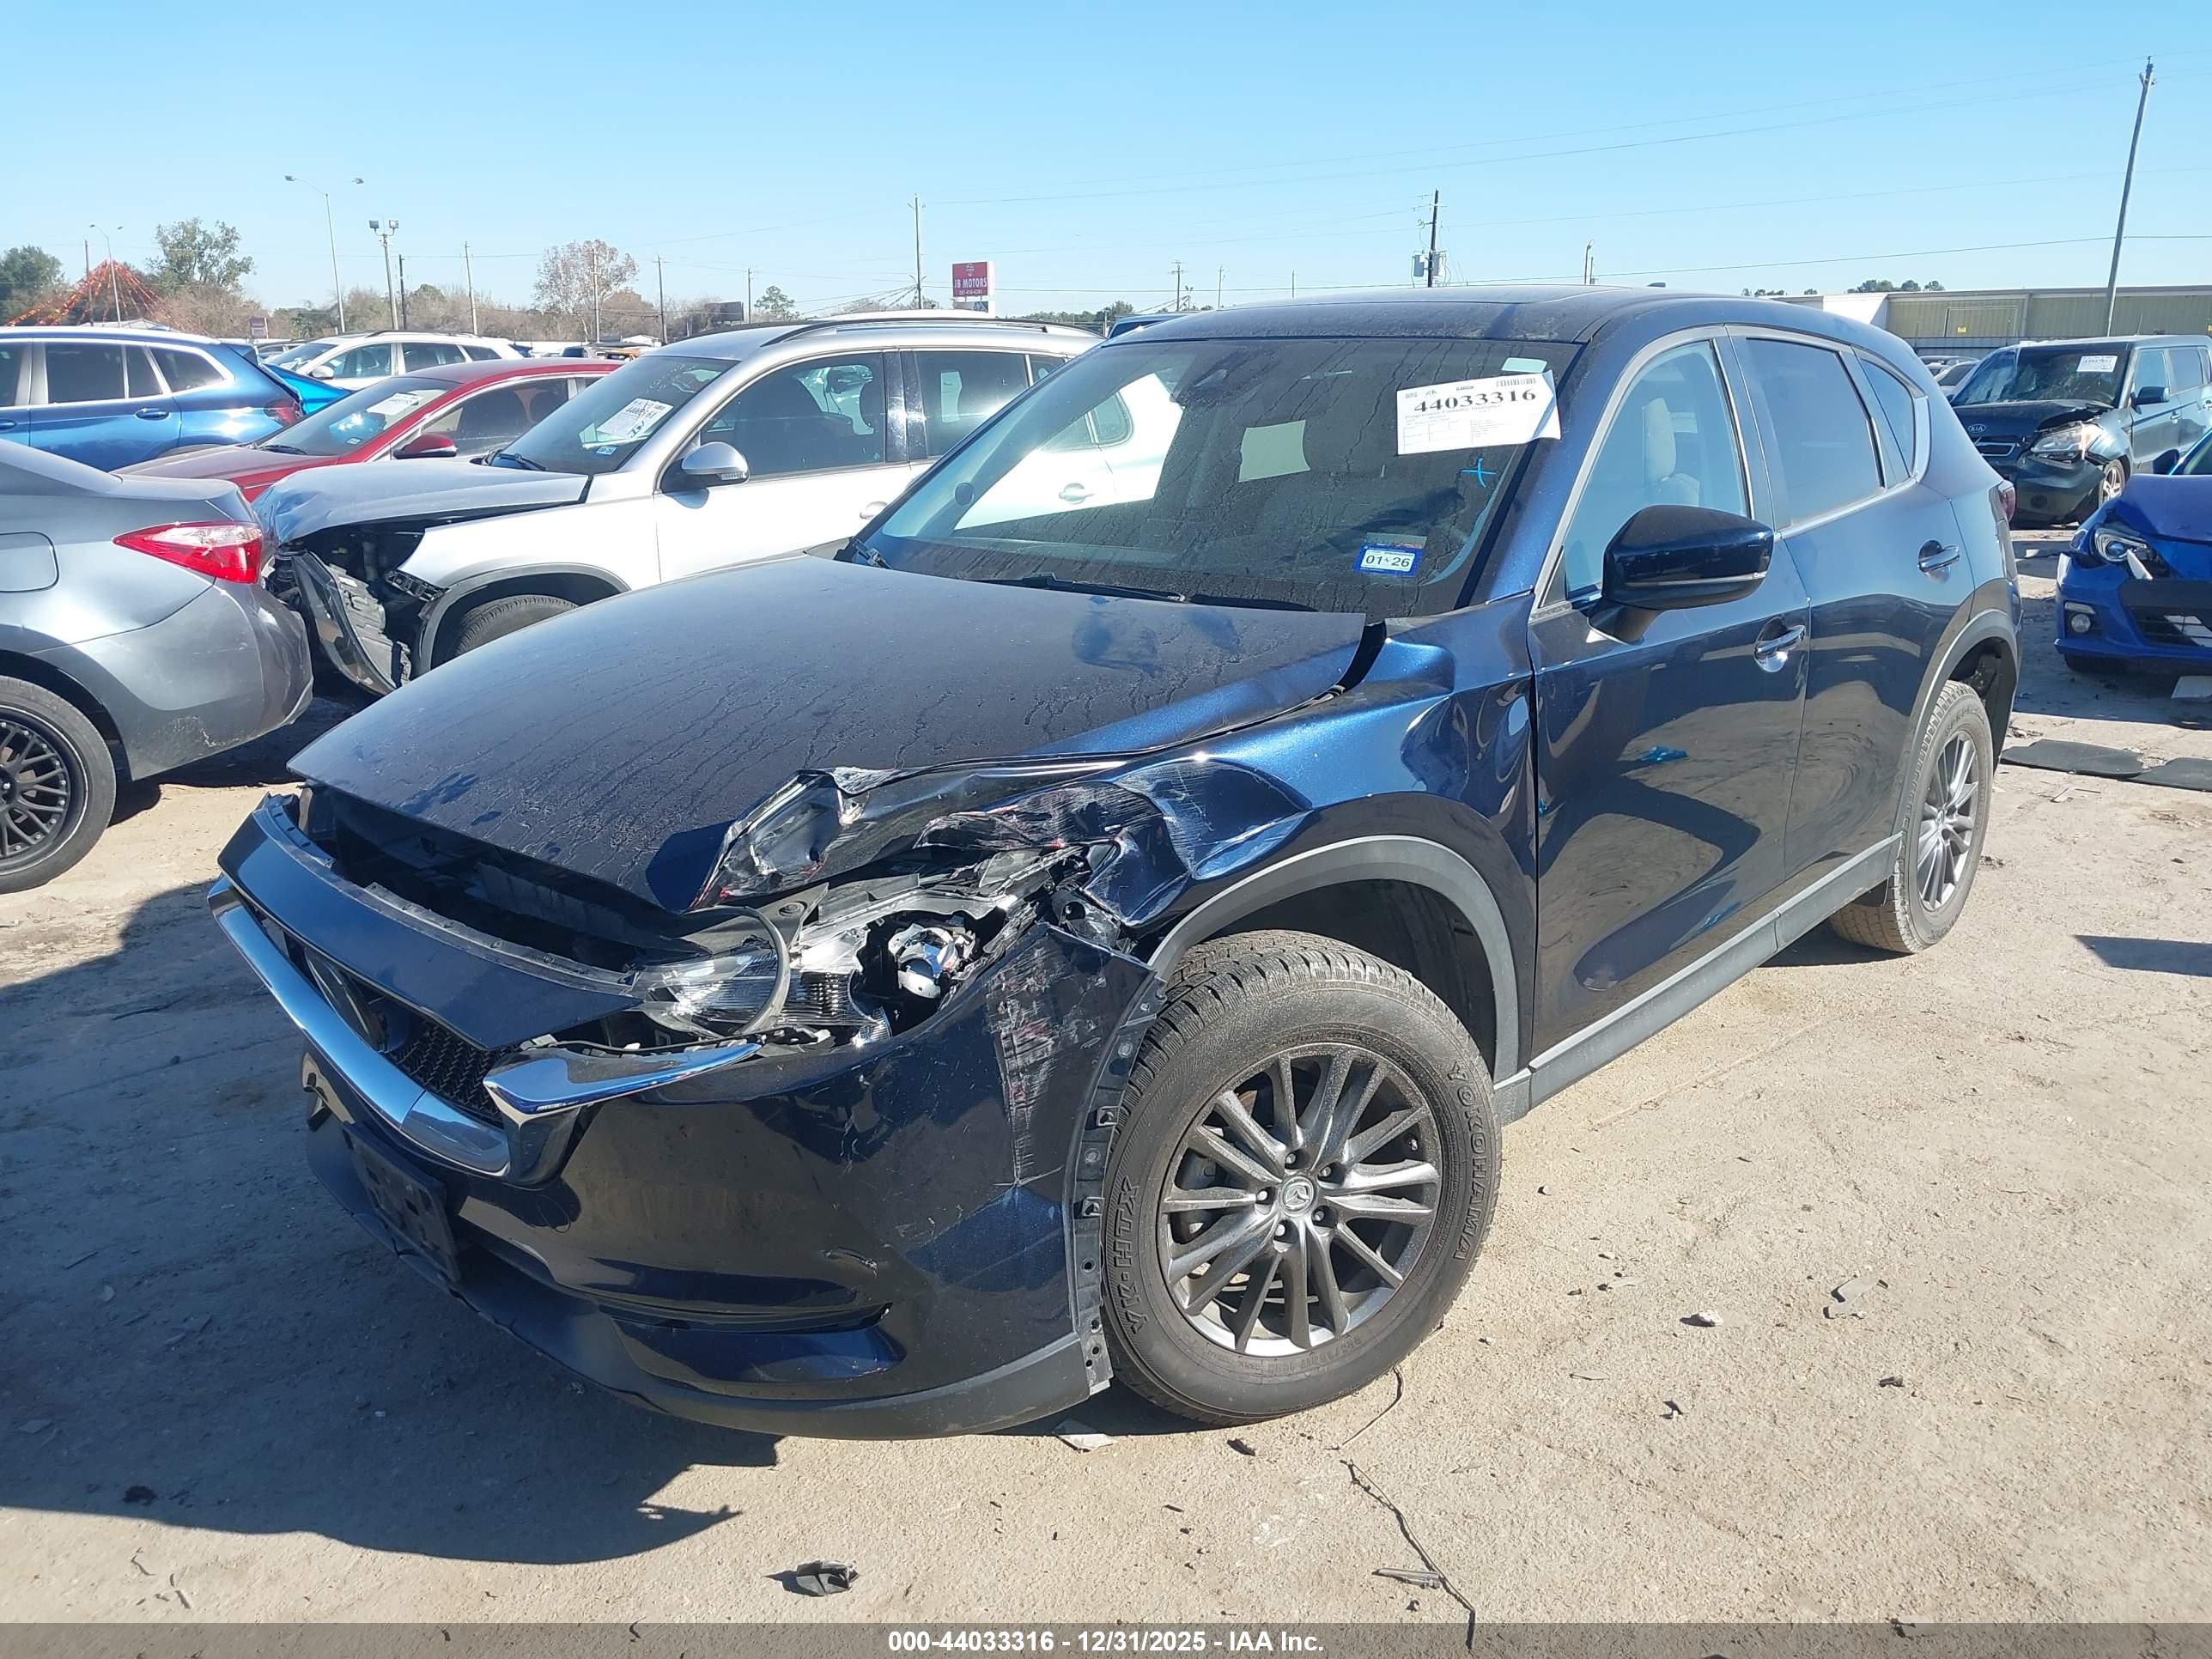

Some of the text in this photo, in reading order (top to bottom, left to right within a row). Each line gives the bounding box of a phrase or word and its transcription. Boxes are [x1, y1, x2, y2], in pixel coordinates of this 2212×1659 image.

[962, 276, 988, 289] MOTORS
[1413, 388, 1536, 412] 44033316
[1391, 556, 1411, 567] 26
[1447, 1061, 1486, 1261] YOKOHAMA
